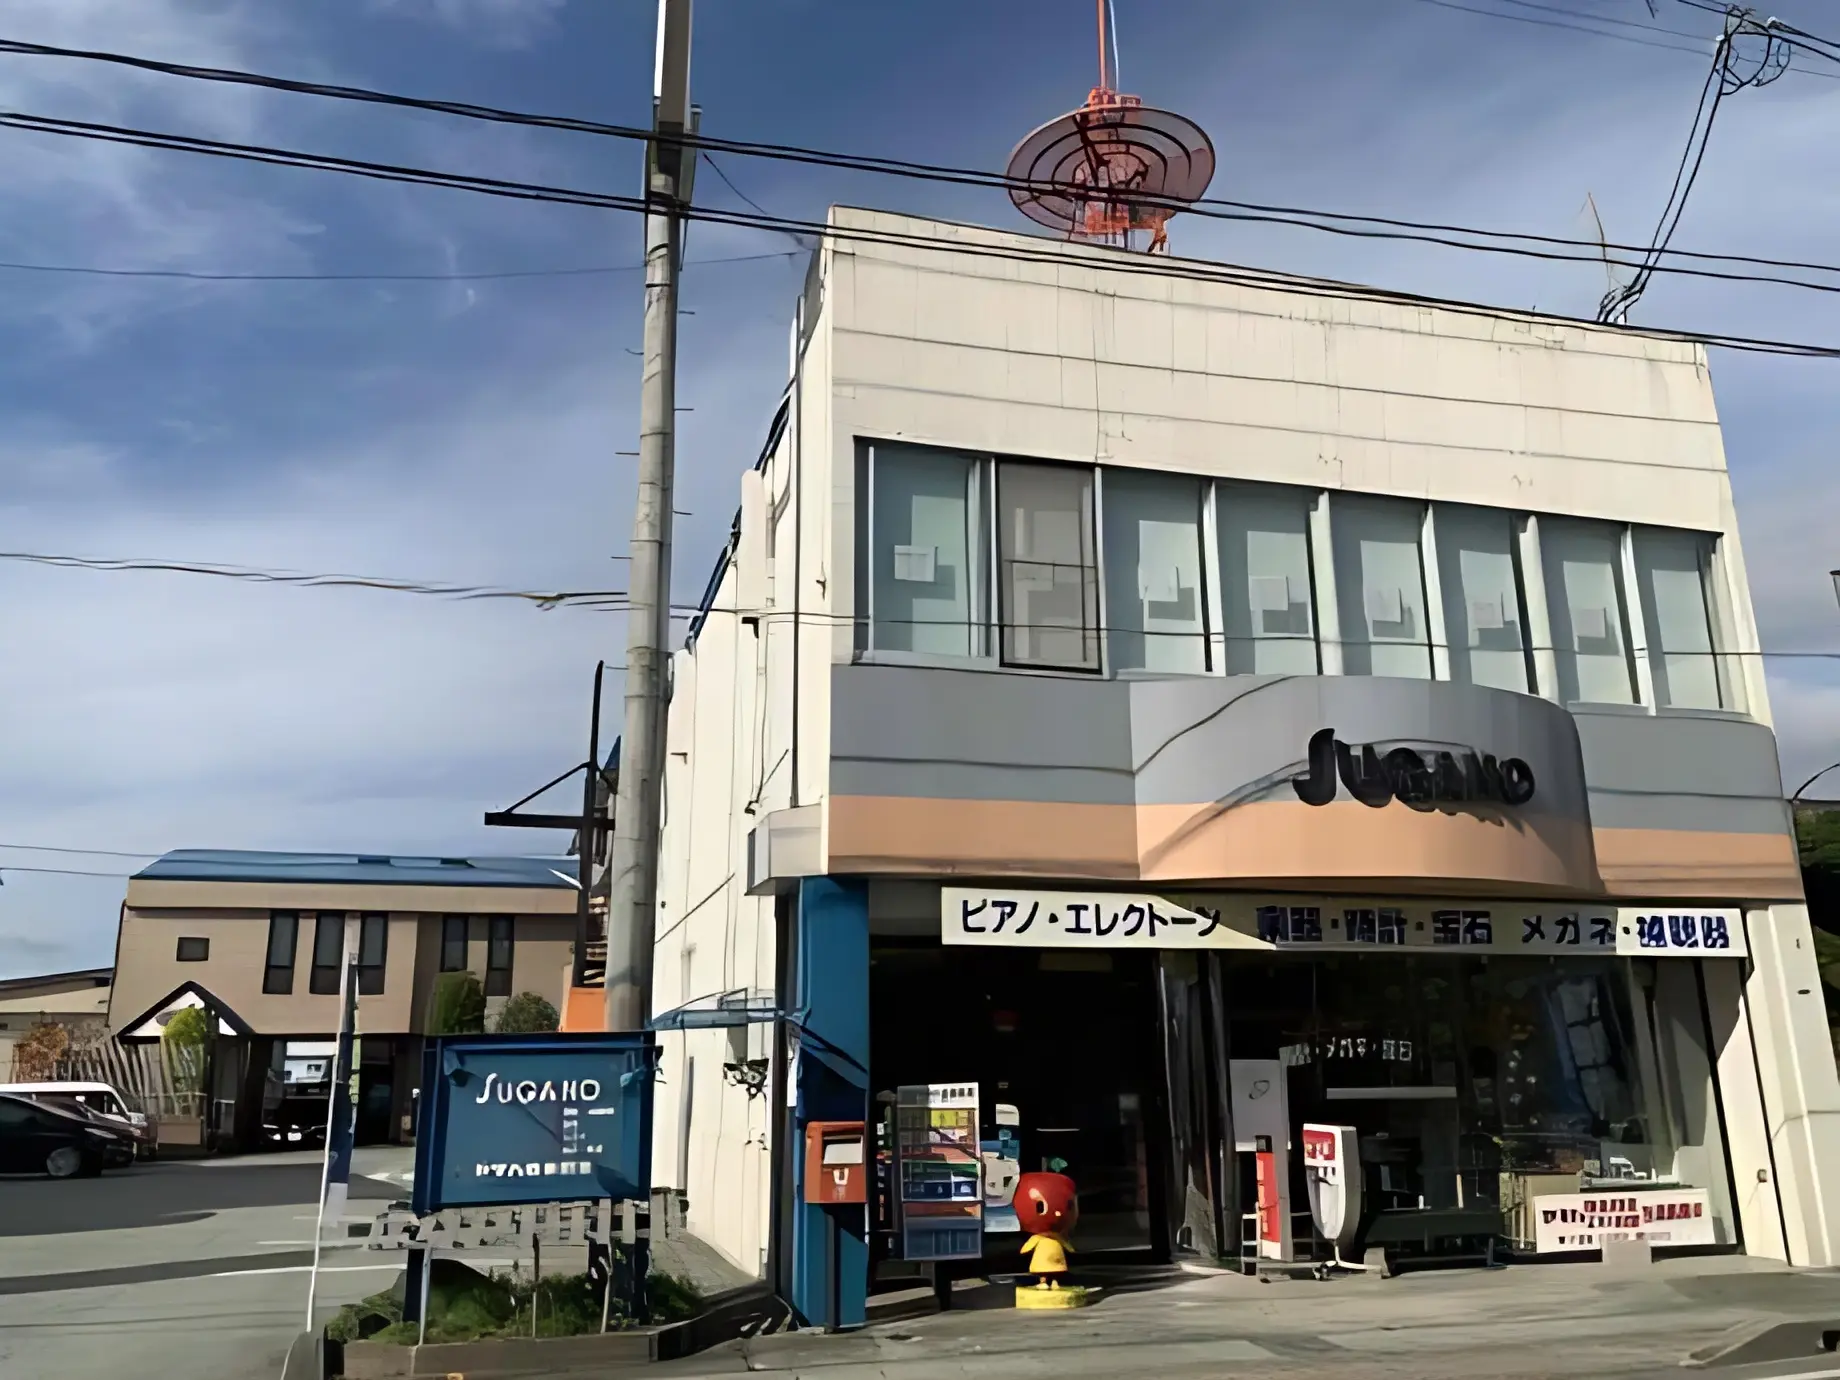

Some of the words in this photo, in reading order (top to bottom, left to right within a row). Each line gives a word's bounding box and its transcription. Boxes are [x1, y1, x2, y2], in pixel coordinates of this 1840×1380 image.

[962, 899, 1221, 938] ピアノ・エレクトーン
